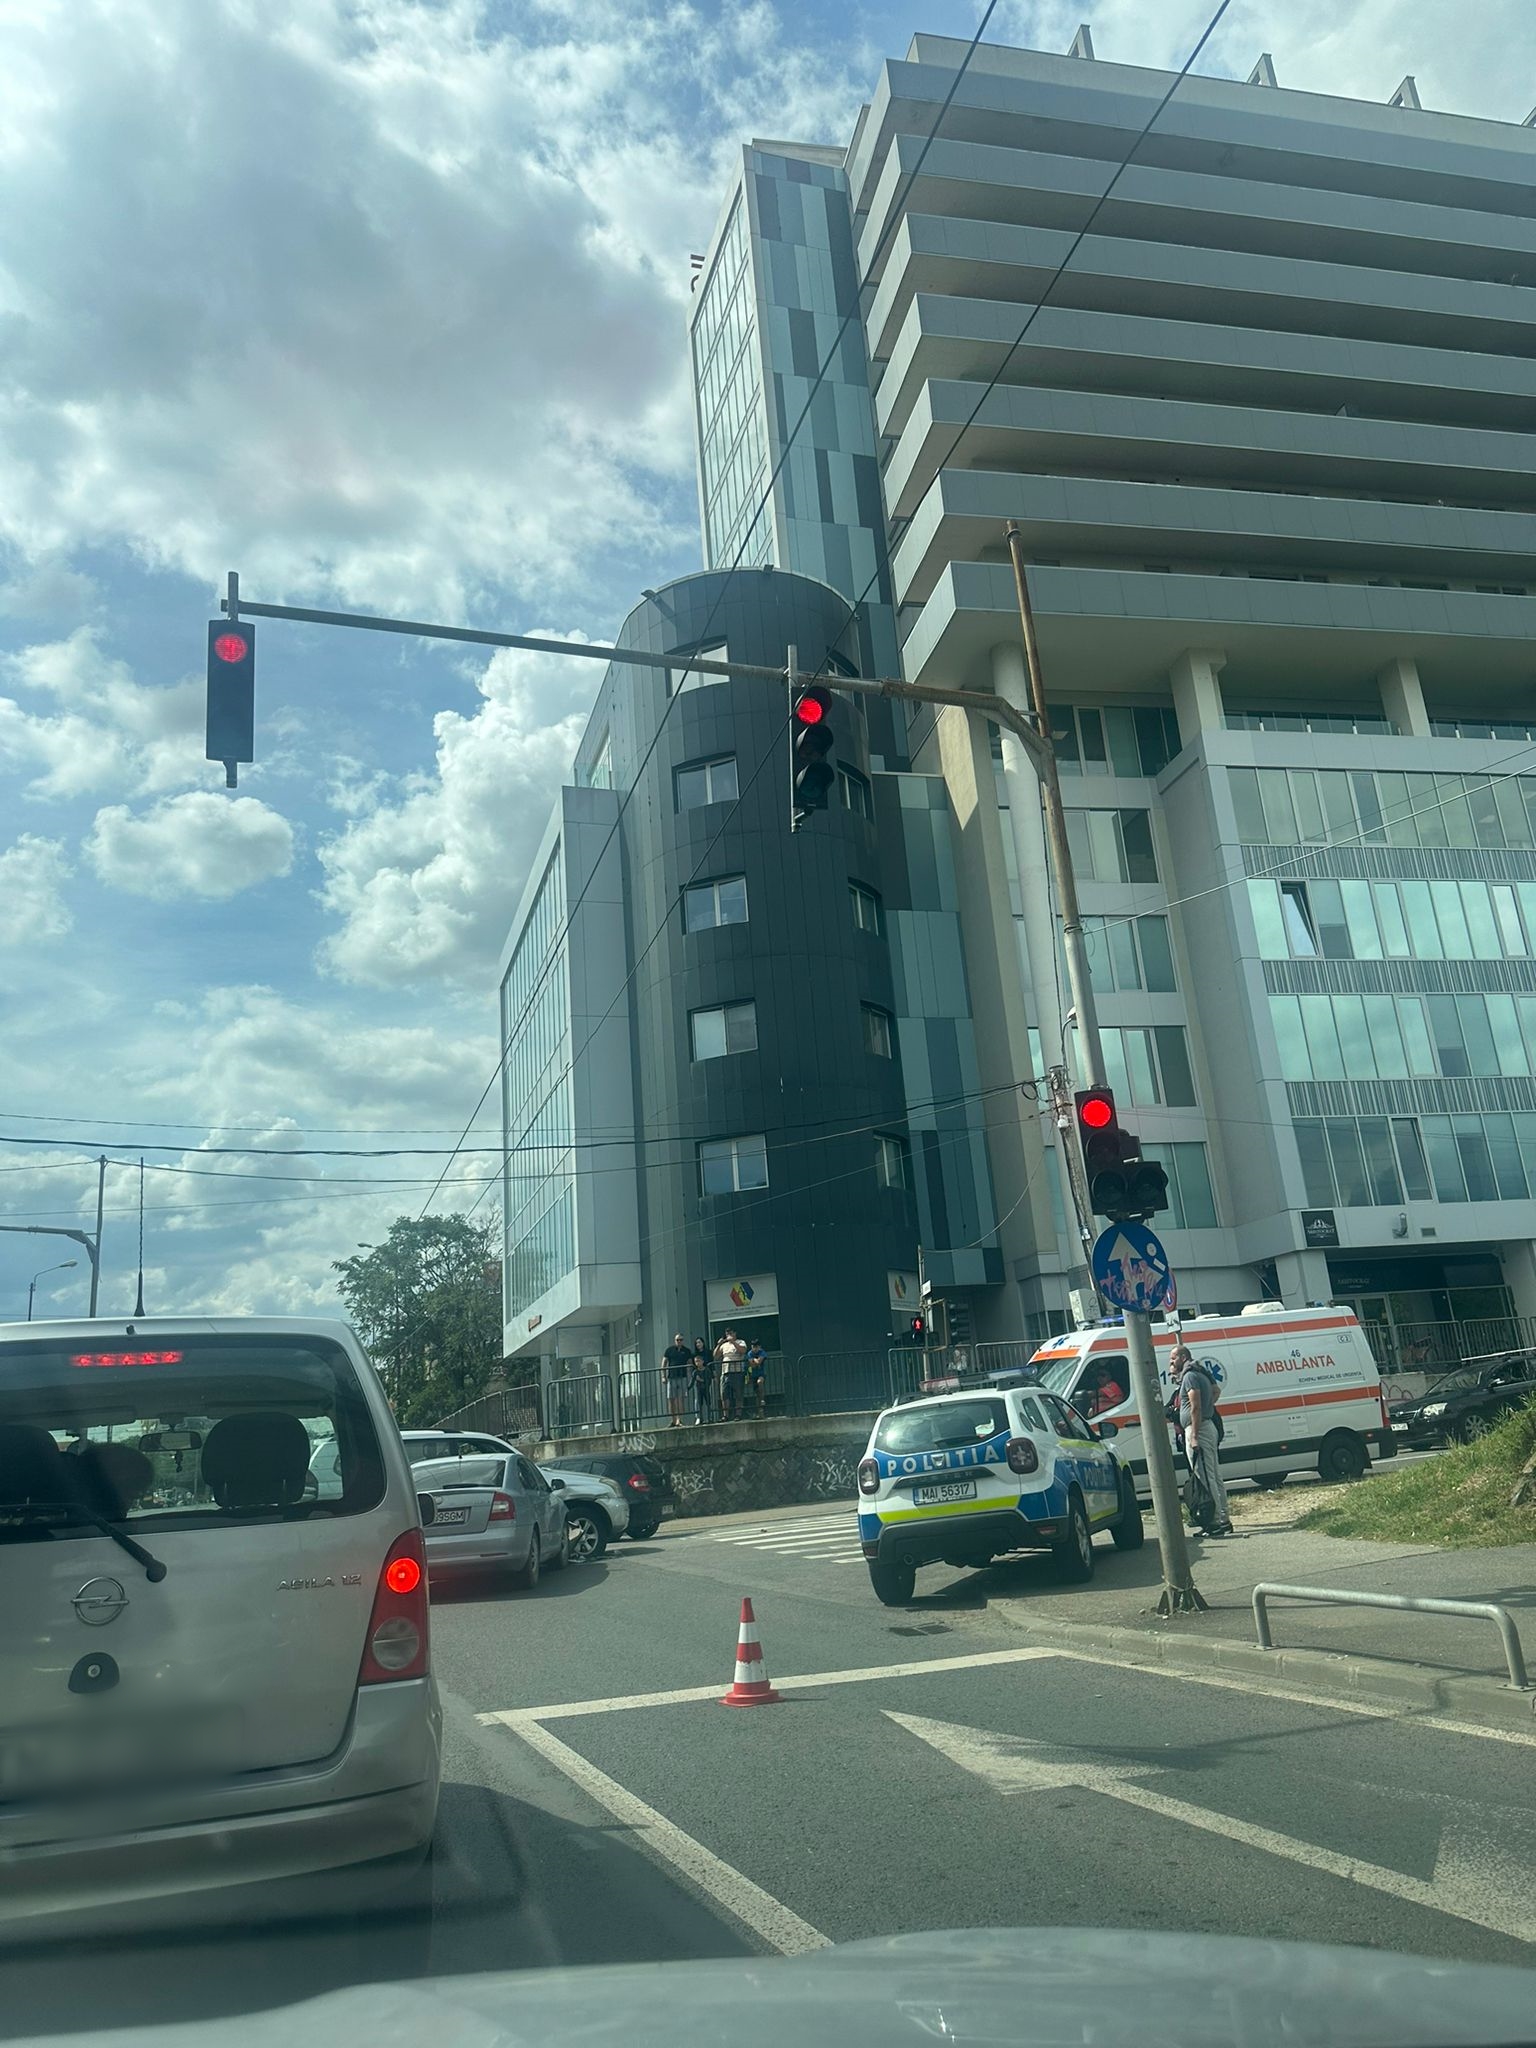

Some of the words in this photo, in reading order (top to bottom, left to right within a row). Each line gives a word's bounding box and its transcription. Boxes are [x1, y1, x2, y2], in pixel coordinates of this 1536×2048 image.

[1256, 1354, 1335, 1375] AMBULANTA
[887, 1445, 1000, 1476] POLITIA
[922, 1487, 938, 1500] MAI
[941, 1483, 970, 1498] 56317
